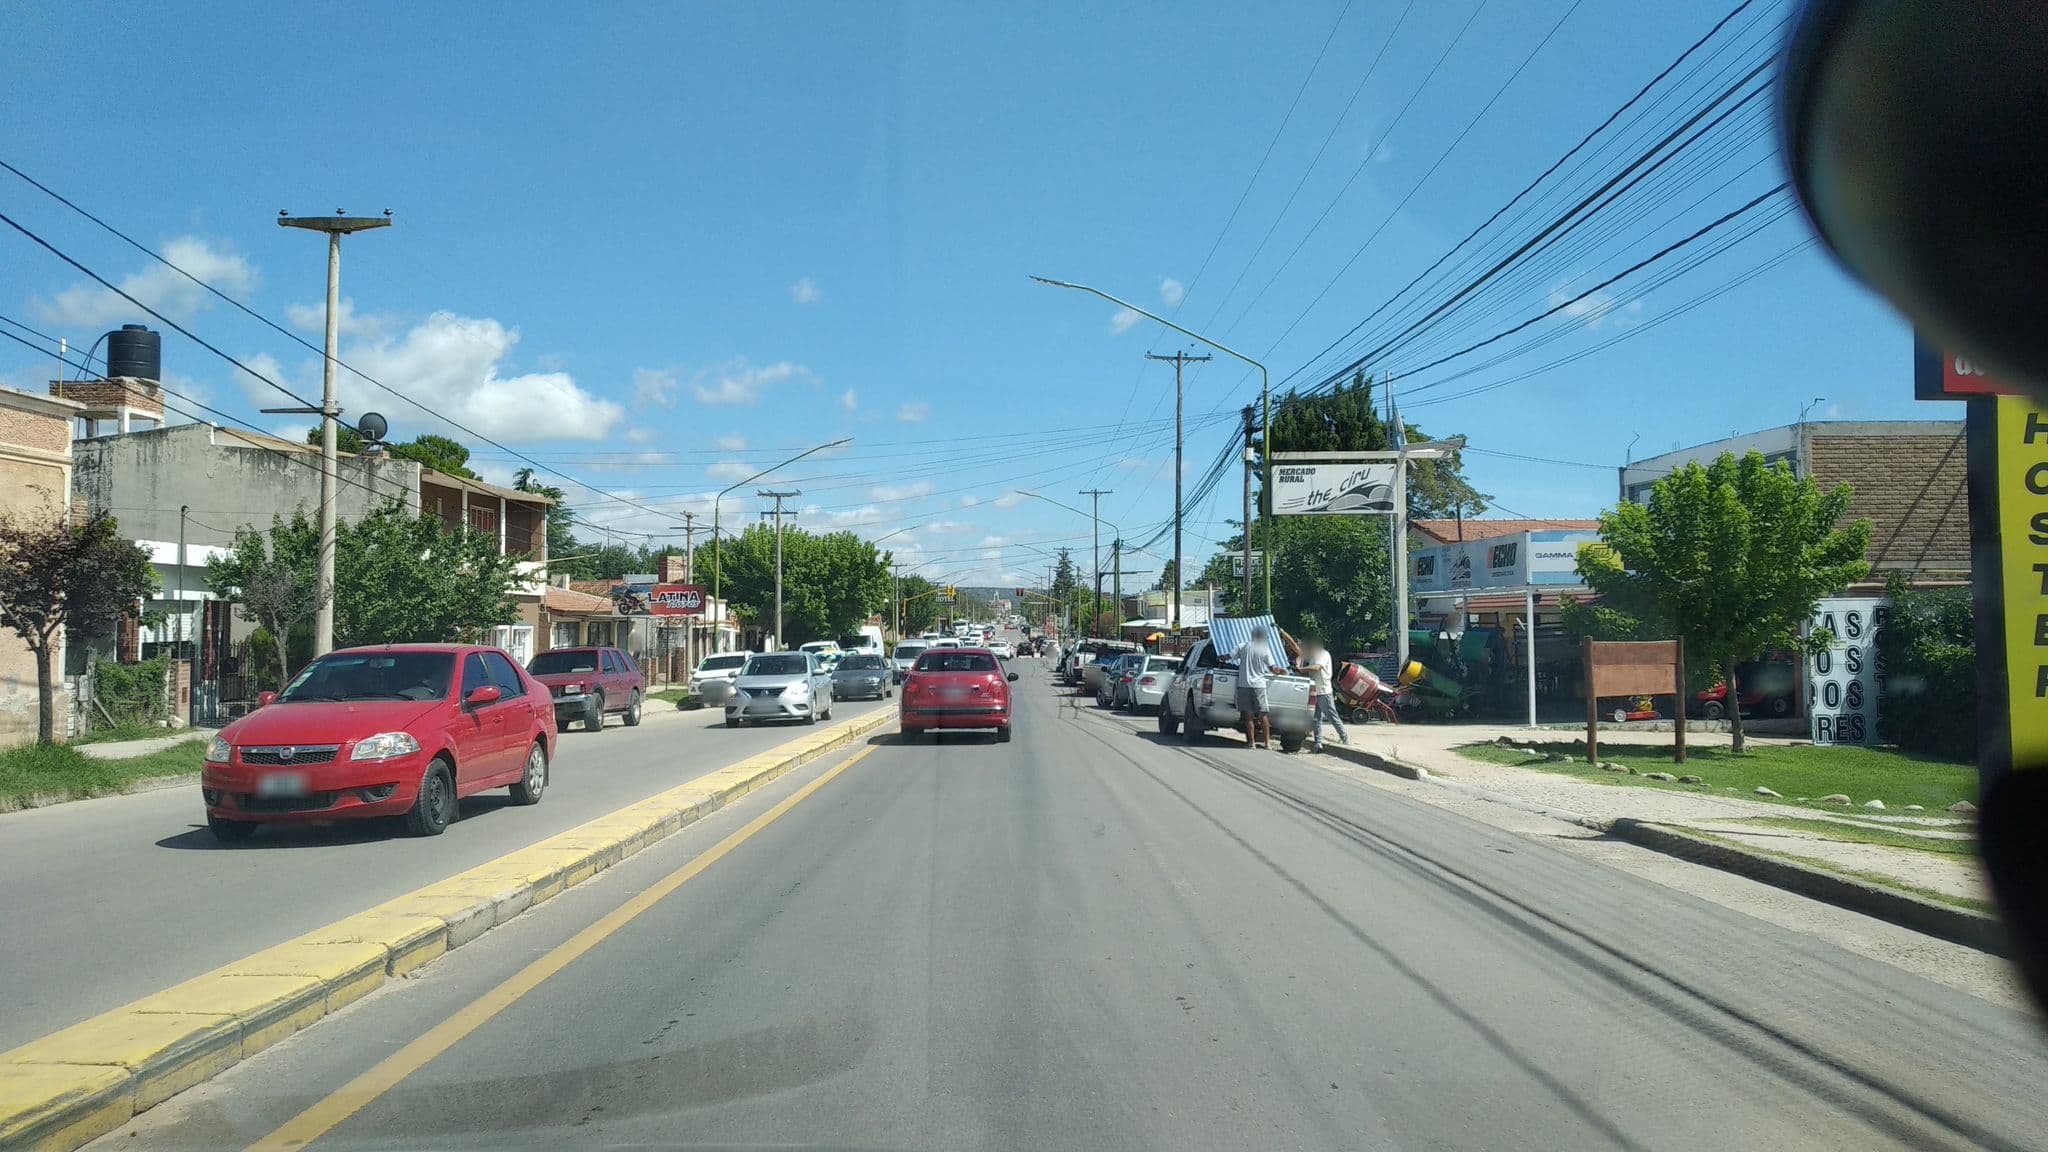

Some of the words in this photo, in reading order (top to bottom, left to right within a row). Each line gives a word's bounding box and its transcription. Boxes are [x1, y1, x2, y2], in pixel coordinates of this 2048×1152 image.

[1278, 468, 1316, 476] MERCADO
[1278, 475, 1305, 483] RURAL
[1307, 488, 1333, 506] the
[1493, 543, 1518, 569] ECHO
[647, 591, 700, 602] LATINA
